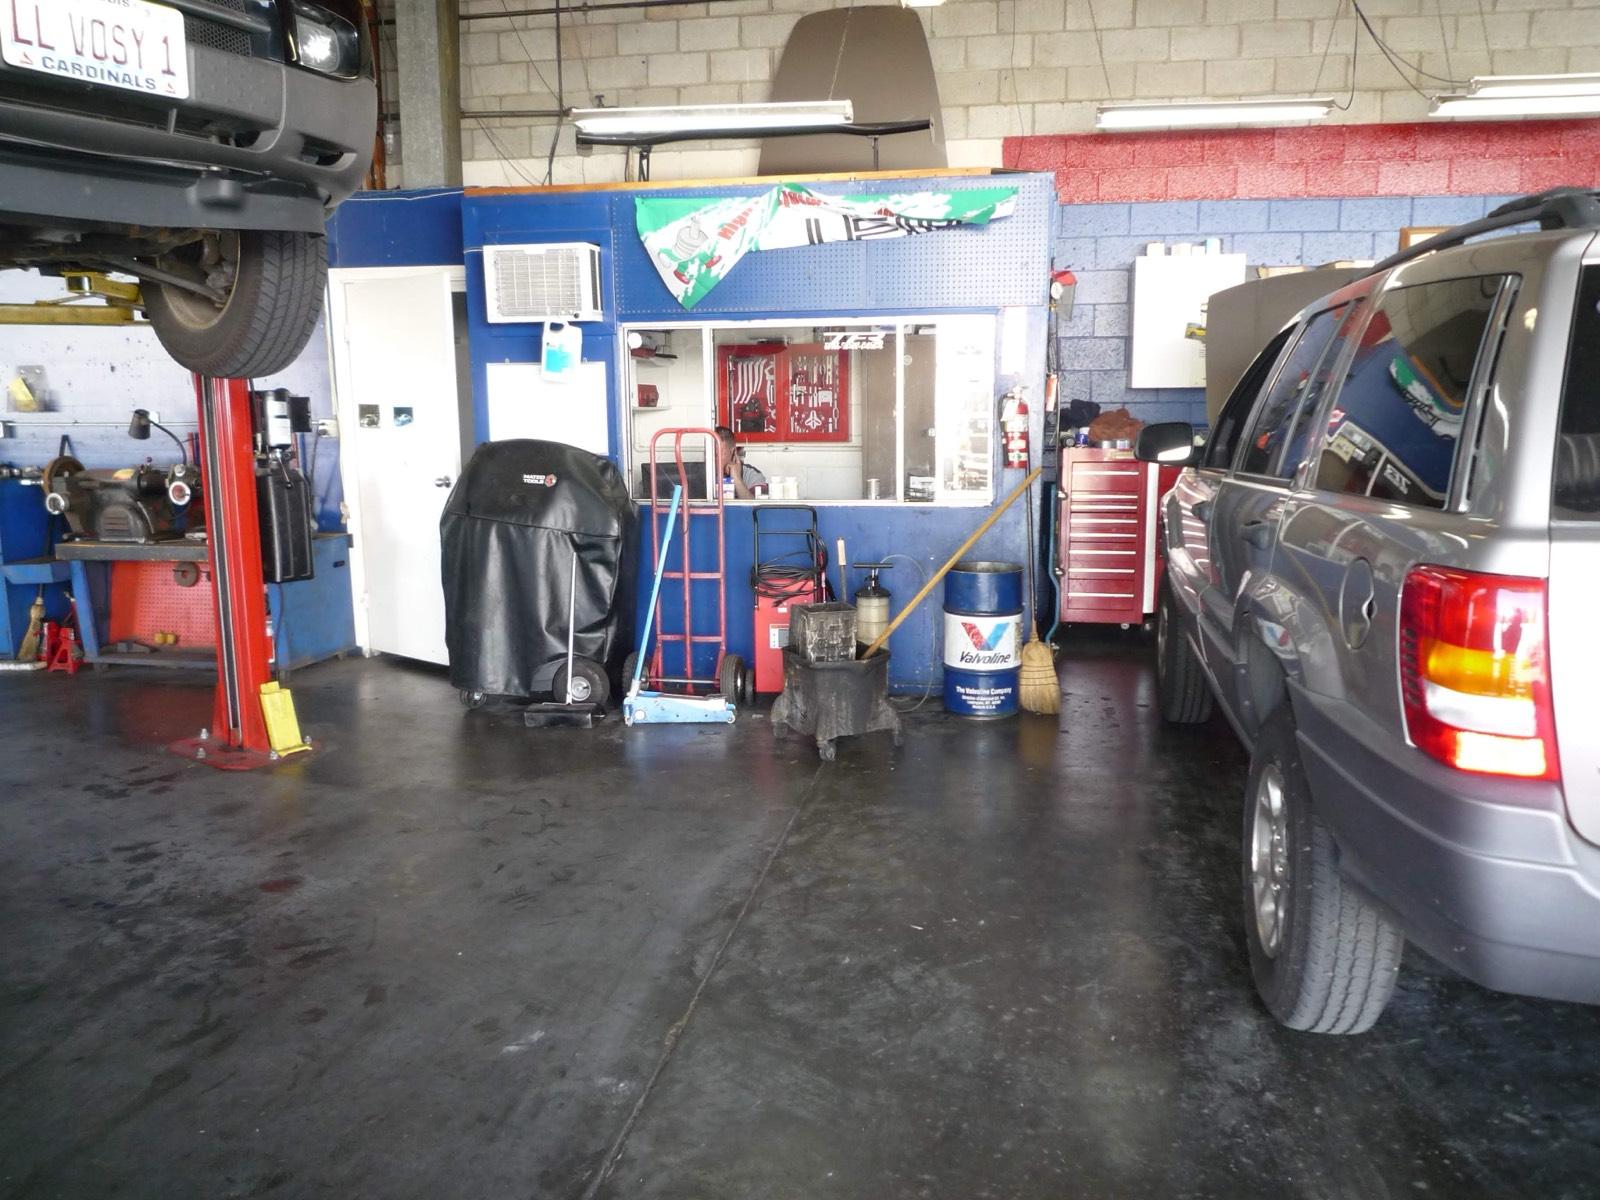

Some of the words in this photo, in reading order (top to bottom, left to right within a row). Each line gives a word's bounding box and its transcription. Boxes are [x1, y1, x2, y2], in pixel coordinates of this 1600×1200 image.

[69, 12, 144, 69] VOSY
[161, 35, 176, 76] 1
[42, 56, 157, 90] CARDINALS
[960, 650, 1011, 664] Valvoline
